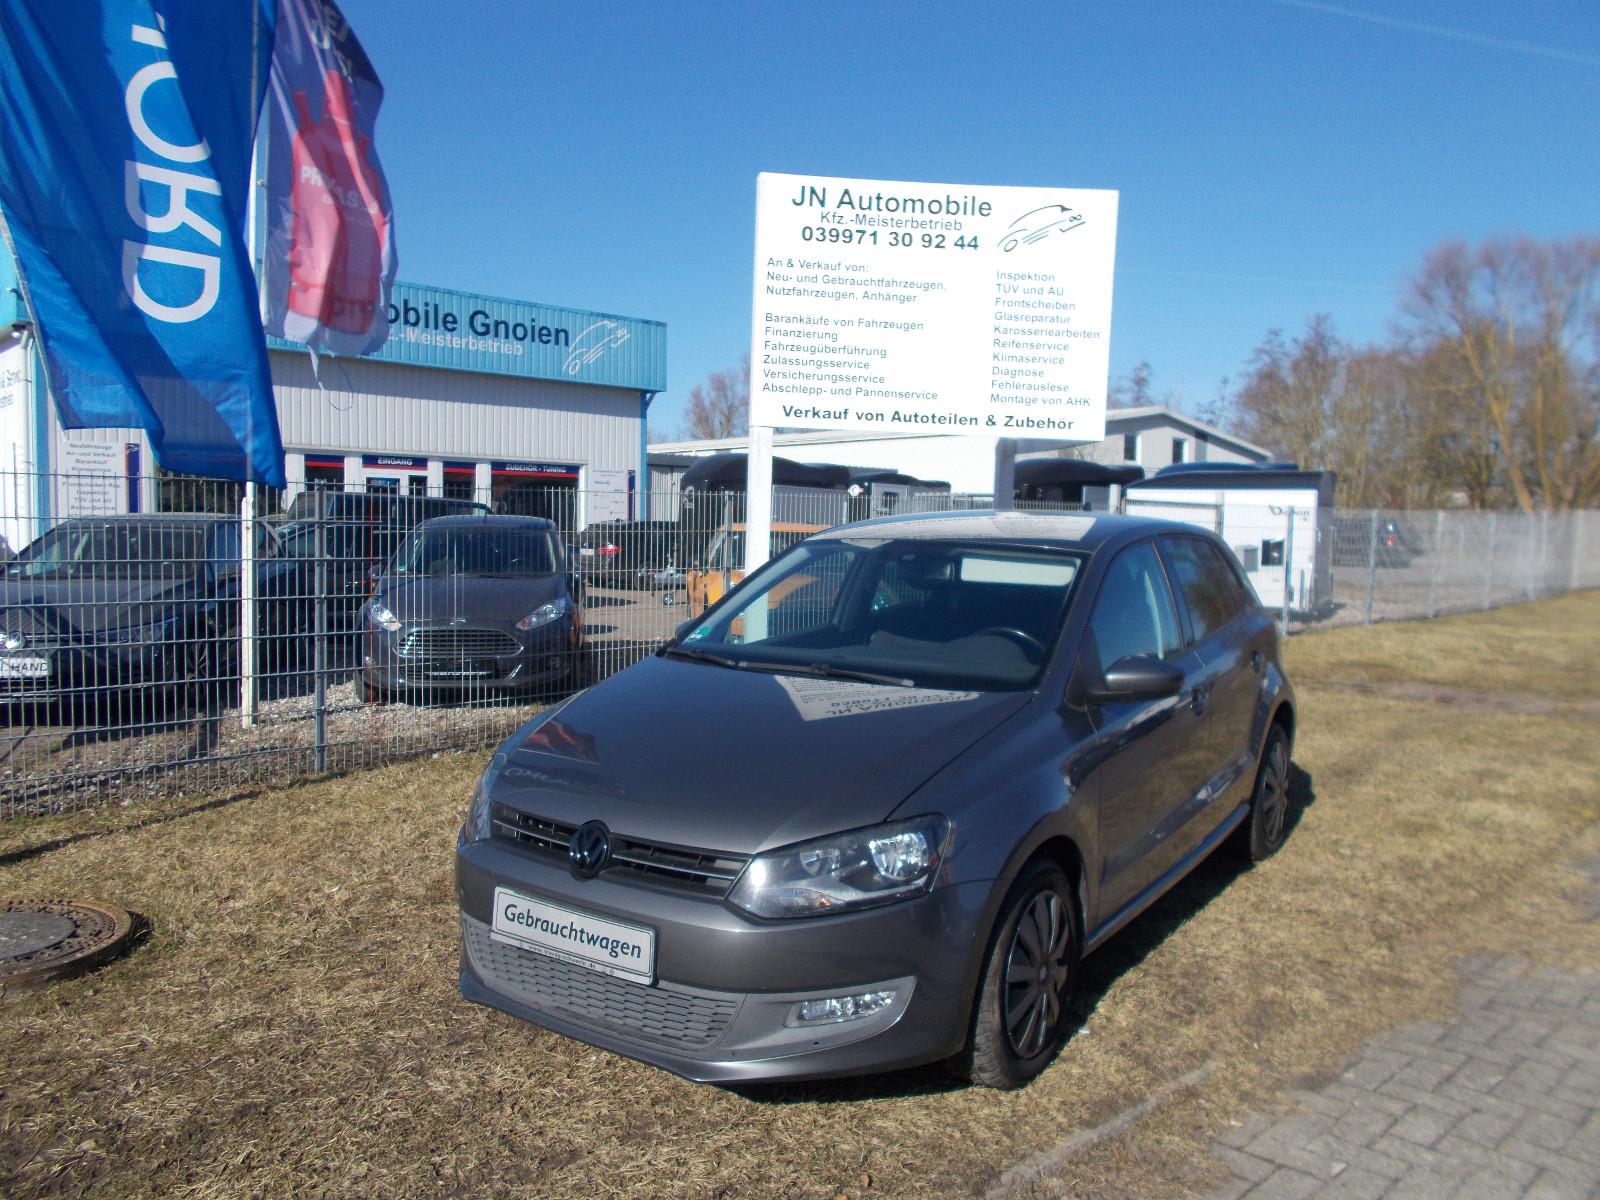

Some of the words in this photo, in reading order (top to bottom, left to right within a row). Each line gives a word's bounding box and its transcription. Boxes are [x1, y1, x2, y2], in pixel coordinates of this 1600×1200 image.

[792, 185, 826, 208] JN
[837, 189, 992, 217] Automobile
[820, 211, 962, 230] Kfz.-Meisterbetrieb
[802, 226, 878, 245] 039971
[888, 232, 913, 247] 30
[921, 233, 946, 249] 92
[953, 235, 979, 250] 44
[767, 257, 783, 268] An
[786, 258, 794, 268] &
[799, 259, 841, 271] Verkauf
[845, 263, 869, 272] von:
[767, 271, 793, 282] Neu-
[796, 274, 817, 284] und
[996, 271, 1055, 283] Inspektion
[862, 290, 917, 304] Anhänger
[1023, 286, 1044, 295] und
[1048, 286, 1064, 296] AU
[995, 297, 1076, 310] Frontscheiben
[765, 312, 830, 326] Barankäufe
[834, 318, 854, 327] von
[858, 318, 924, 332] Fahrzeugen
[994, 311, 1071, 324] Glasreparatur
[469, 309, 570, 347] Gnoien
[764, 327, 838, 342] Finanzierung
[994, 325, 1100, 339] Karosseriearbeiten
[764, 340, 887, 358] Fahrzeugüberführung
[993, 339, 1070, 351] Reifenservice
[763, 355, 870, 370] Zulassungsservice
[992, 353, 1065, 365] Klimaservice
[763, 369, 885, 384] Versicherungsservice
[992, 366, 1045, 379] Diagnose
[763, 382, 827, 397] Abschlepp-
[830, 386, 852, 396] und
[855, 387, 938, 400] Pannenservice
[991, 379, 1070, 392] Fehlerauslese
[990, 393, 1038, 406] Montage
[1042, 397, 1062, 406] von
[1066, 396, 1090, 406] AHK
[783, 405, 849, 420] Verkauf
[856, 411, 884, 422] von
[891, 410, 978, 426] Autoteilen
[985, 414, 997, 427] &
[1004, 415, 1074, 430] Zubehör
[377, 457, 413, 466] EINGANG
[504, 903, 641, 959] Gebrauchtwagen
